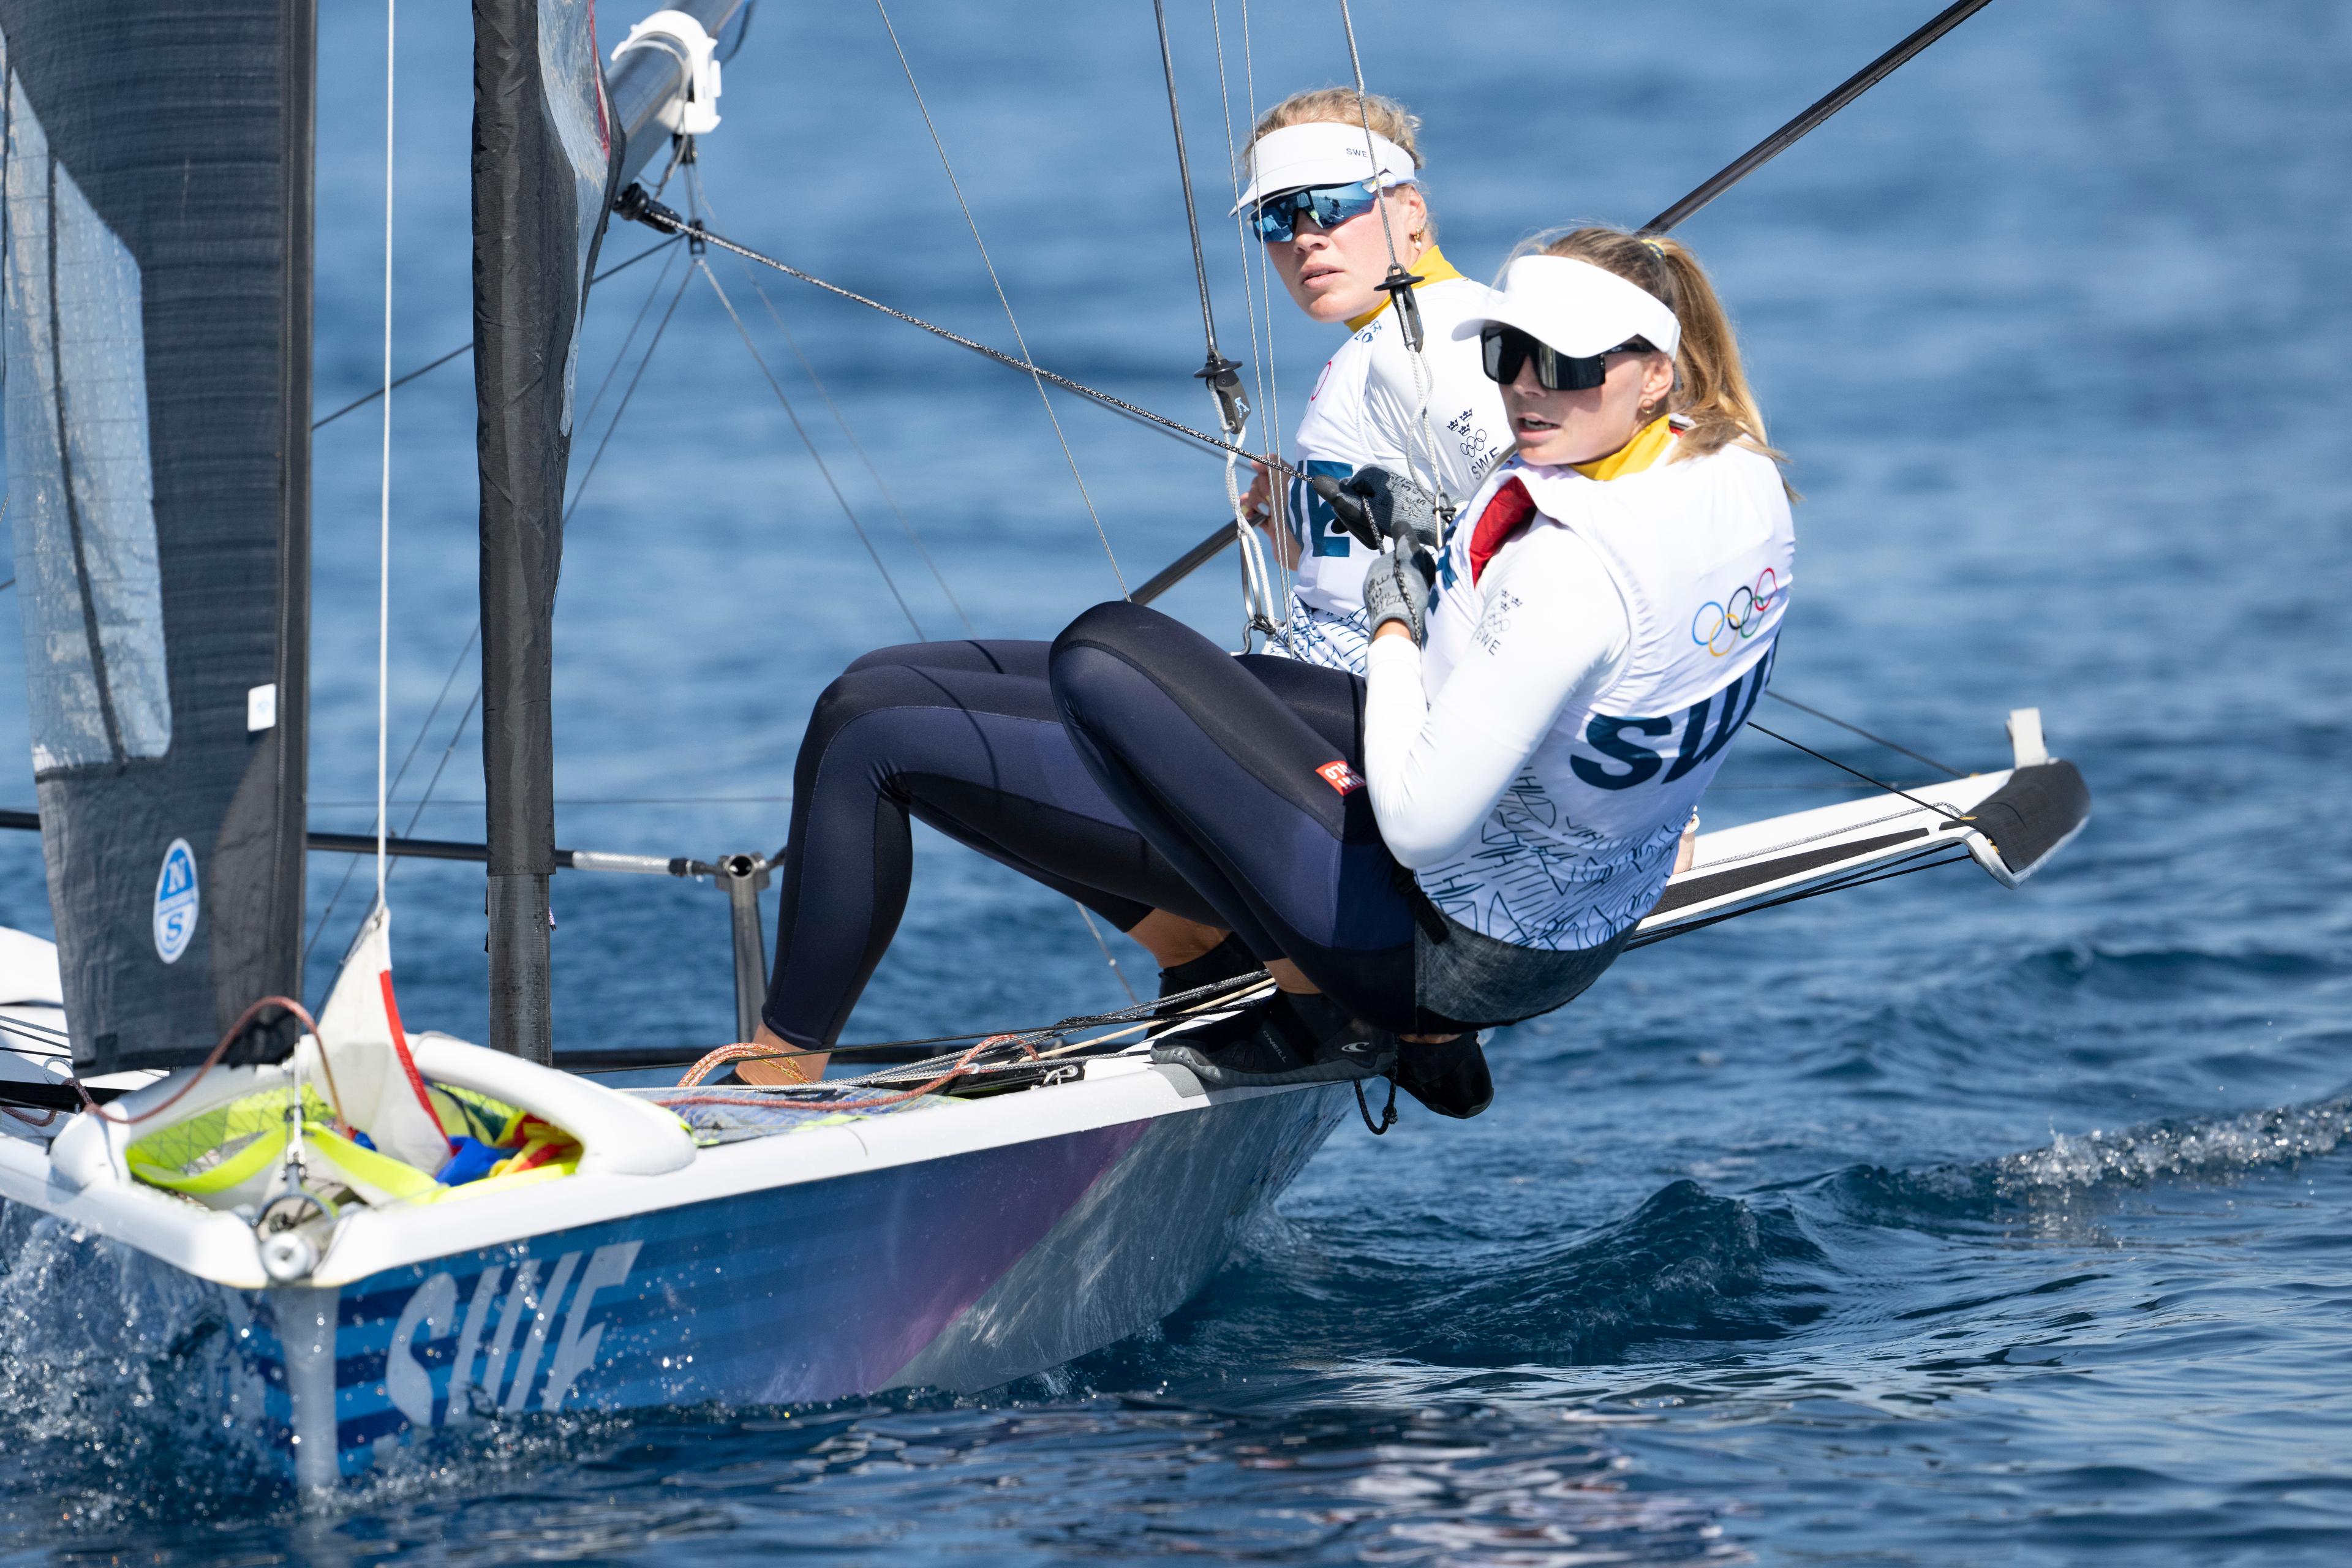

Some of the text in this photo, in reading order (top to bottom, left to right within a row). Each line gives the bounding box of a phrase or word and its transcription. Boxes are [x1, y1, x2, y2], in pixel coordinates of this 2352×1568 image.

[1346, 148, 1368, 158] SWE
[1471, 447, 1500, 481] SWE
[1324, 763, 1352, 780] QLO
[1336, 775, 1366, 790] UNI
[167, 856, 187, 894] N
[166, 911, 184, 942] S
